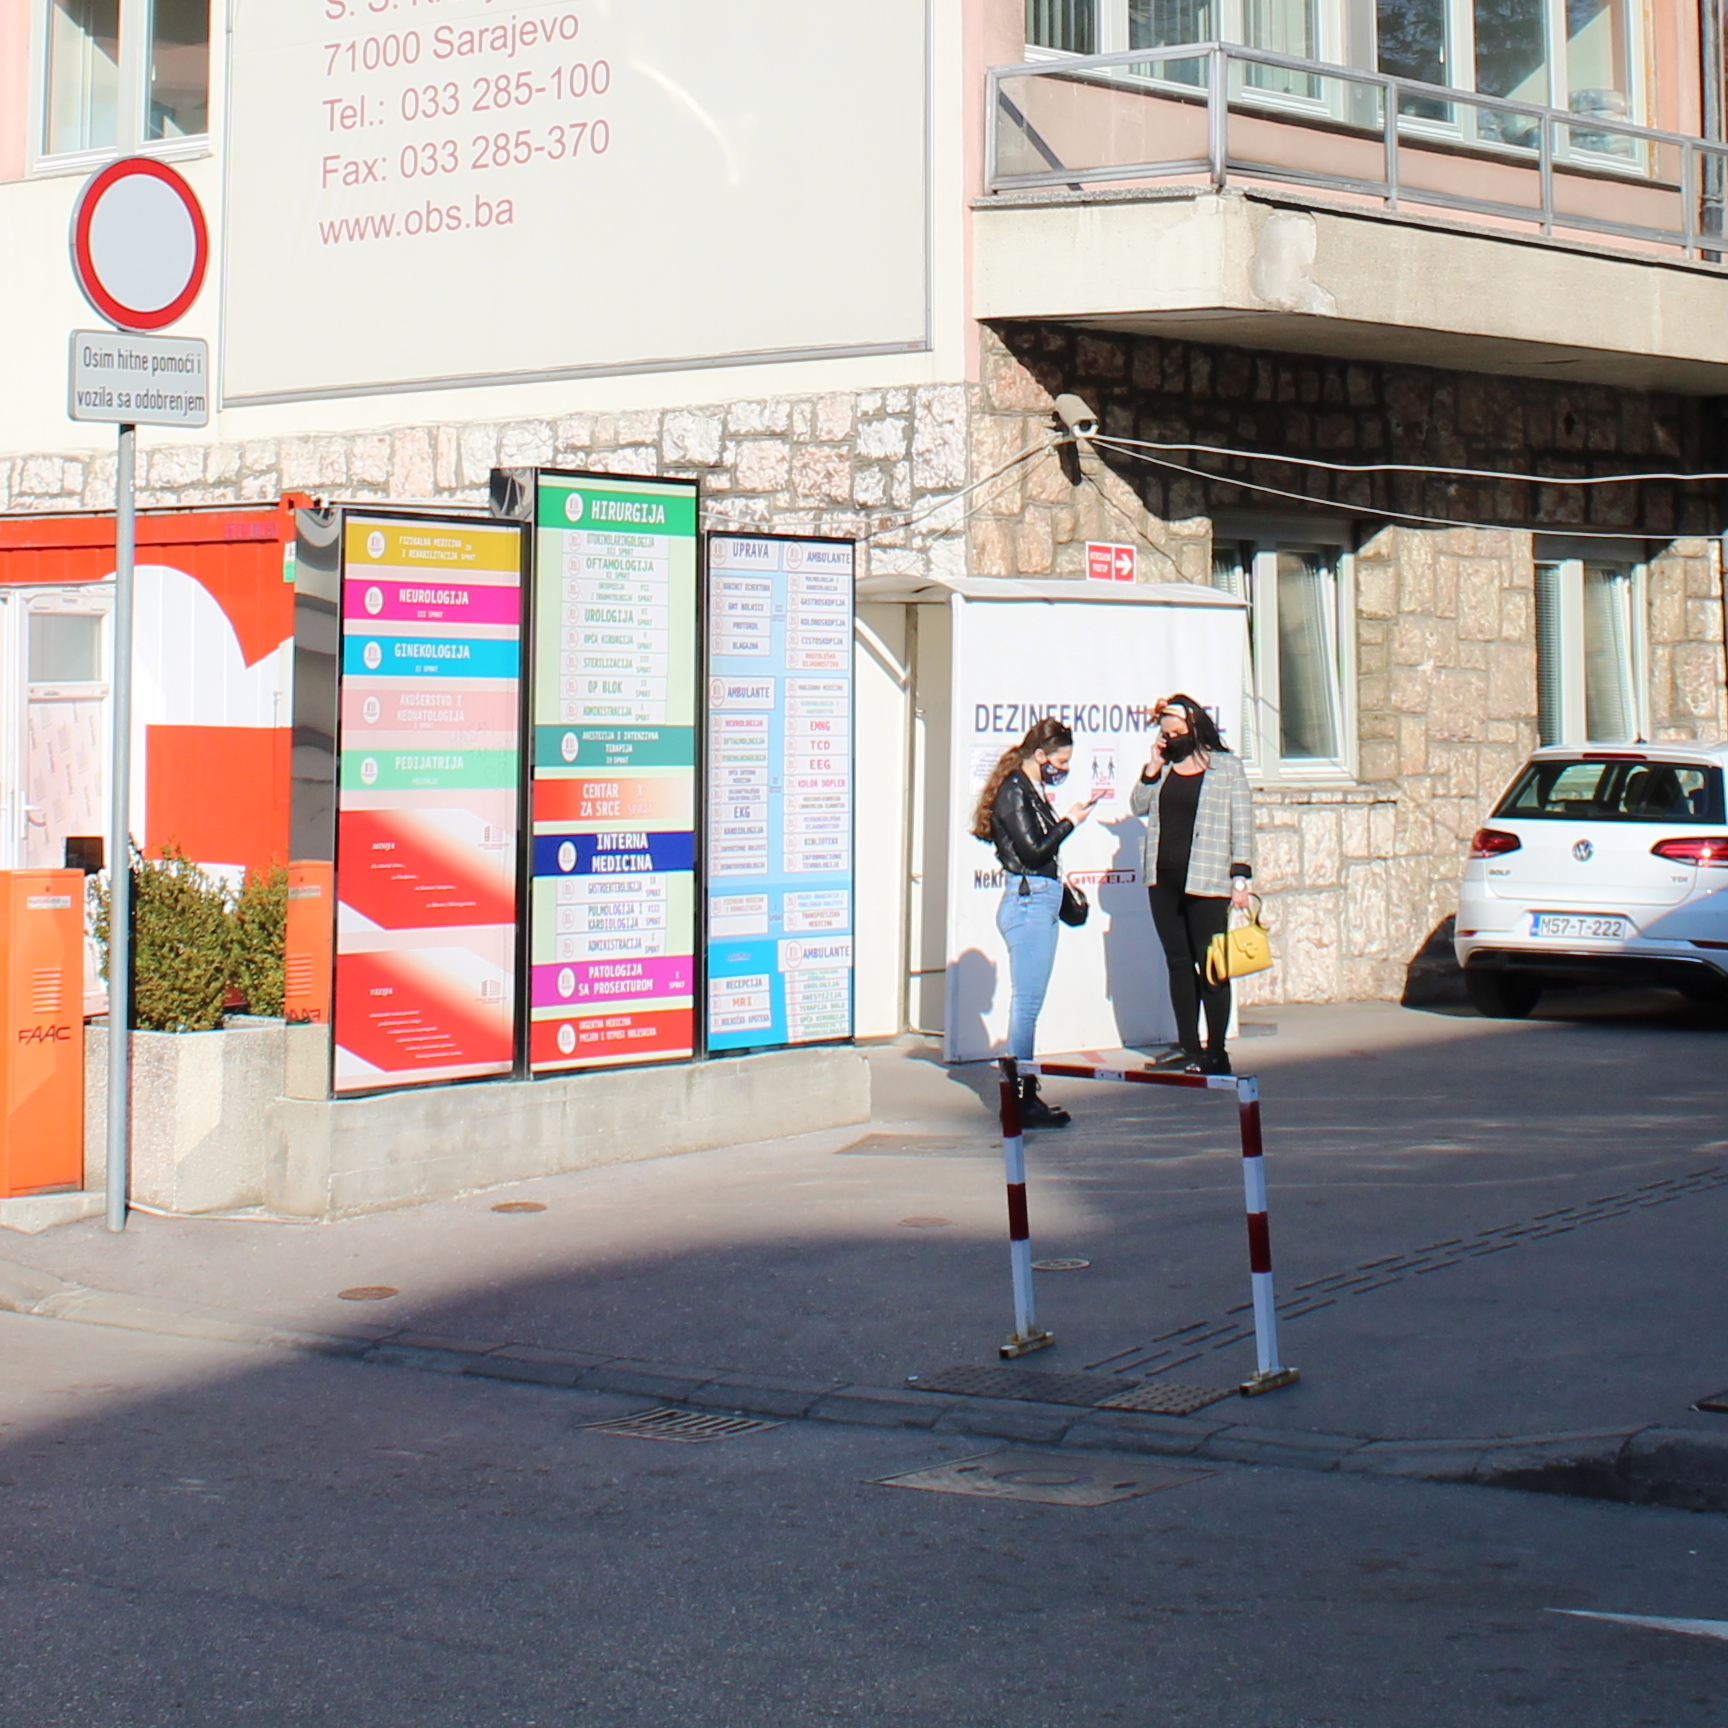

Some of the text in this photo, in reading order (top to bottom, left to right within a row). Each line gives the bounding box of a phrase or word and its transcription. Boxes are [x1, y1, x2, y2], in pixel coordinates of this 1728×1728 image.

[324, 13, 579, 76] 71000 Sarajevo
[322, 59, 612, 132] Tel.: 033 285-100
[321, 118, 611, 189] Fax: 033 285-370
[319, 193, 514, 245] www.obs.ba
[83, 345, 202, 377] Osim hitne pomoći i
[77, 386, 206, 417] vozila sa odobrenjem
[591, 500, 666, 524] HIRURGIJA
[732, 542, 770, 559] UPRAVA
[586, 557, 654, 572] OFTAMOLOGIJA
[807, 552, 851, 565] AMBULANTE
[399, 589, 470, 605] NEUROLOGIJA
[584, 608, 634, 624] UROLOGIJA
[394, 643, 470, 659] GINEKOLOGIJA
[583, 657, 633, 669] STERILIZACIJA
[587, 680, 623, 694] OP BLOK
[727, 686, 770, 699] AMBULANTE
[400, 693, 462, 707] AKUŠERSTVO I
[397, 710, 465, 722] NEONATOLOGIJA
[810, 740, 831, 751] TCD
[395, 756, 464, 770] PEDIJATRIJA
[809, 759, 831, 770] EEG
[583, 783, 619, 799] CENTAR
[580, 801, 621, 816] ZA SRCE
[733, 805, 751, 819] EKG
[596, 832, 648, 851] INTERNA
[804, 837, 839, 846] BIBLIOTEKA
[591, 854, 653, 872] MEDICINA
[588, 917, 639, 930] KARDIOLOGIJA
[1540, 917, 1622, 937] M57-T-222
[588, 938, 642, 952] ADMINISTRACIJA
[803, 945, 850, 960] AMBULANTE
[588, 963, 643, 979] PATOLOGIJA
[578, 979, 654, 997] SA PROSEKTUROM
[726, 978, 763, 990] RECEPCIJA
[732, 996, 753, 1007] MRI
[18, 1024, 71, 1046] FAAC
